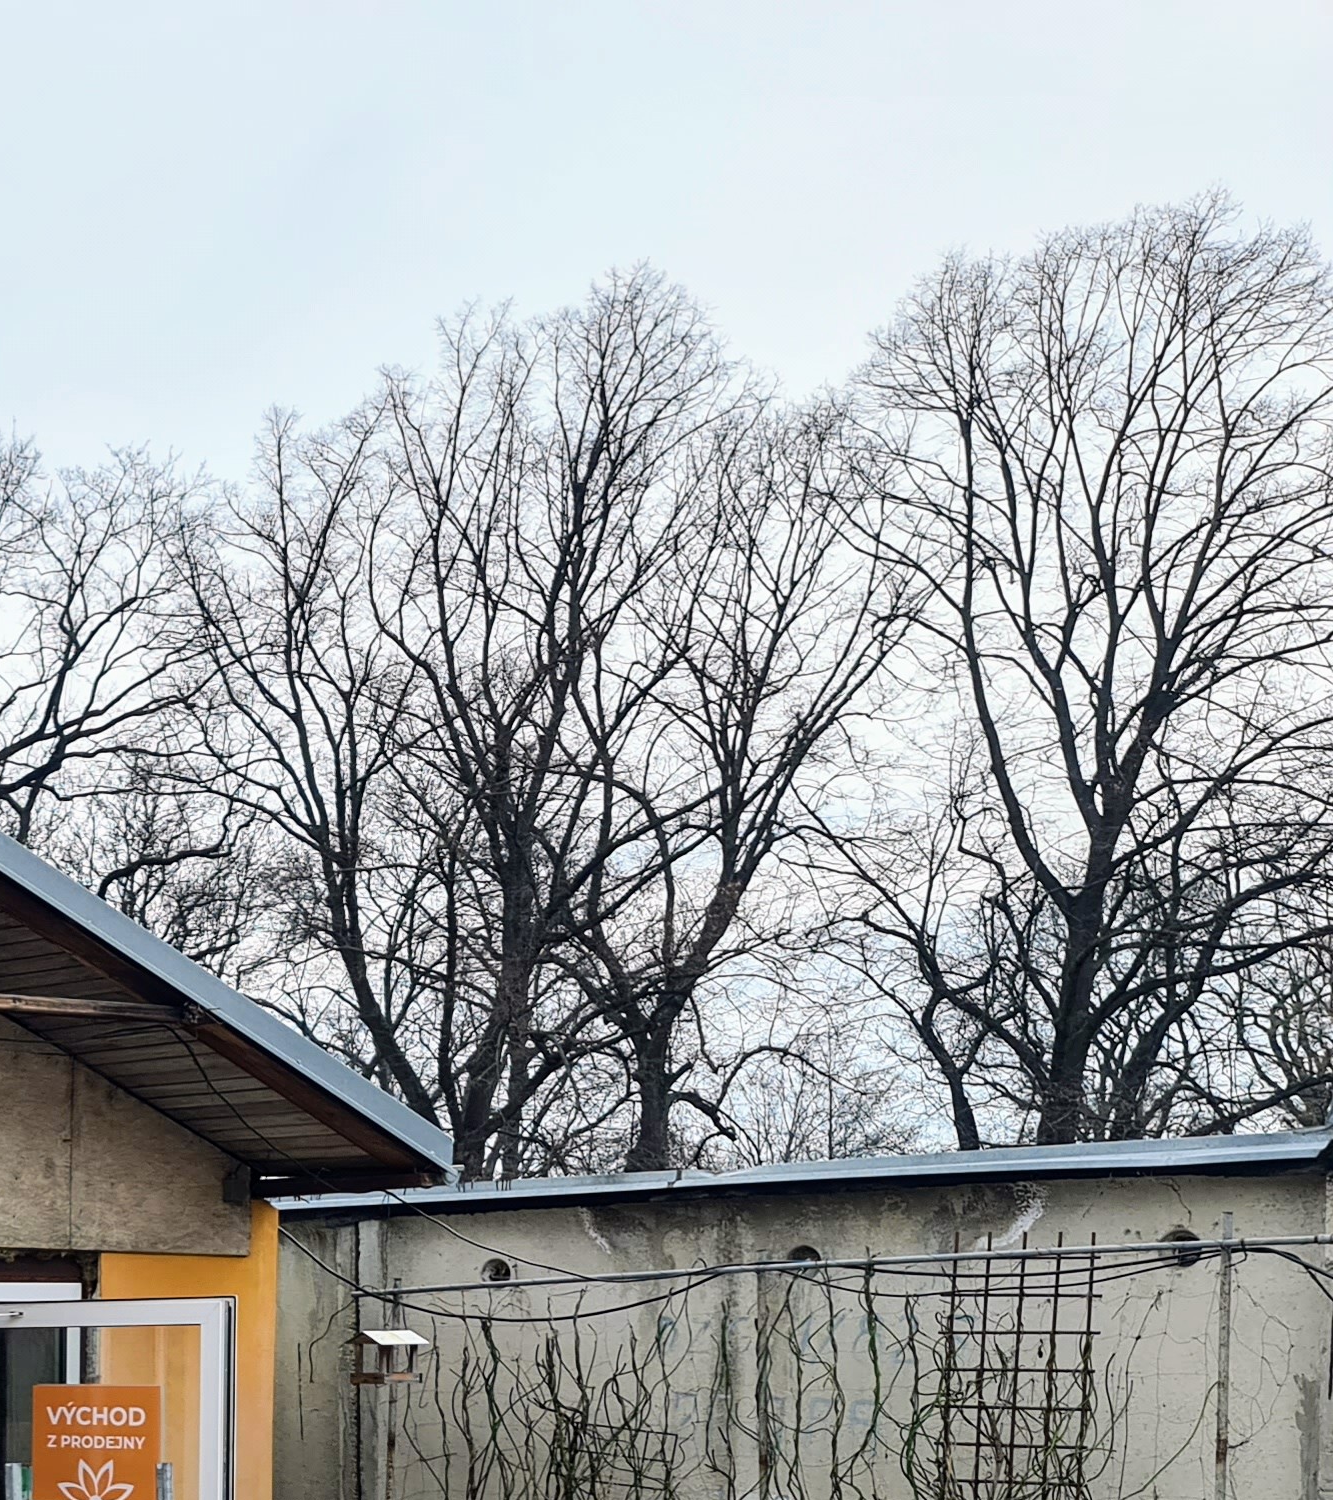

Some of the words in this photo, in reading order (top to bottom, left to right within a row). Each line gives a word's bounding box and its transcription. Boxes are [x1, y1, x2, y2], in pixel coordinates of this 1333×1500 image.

[46, 1401, 146, 1426] VÝCHOD
[47, 1434, 57, 1448] Z
[61, 1435, 146, 1449] PRODEJNY
